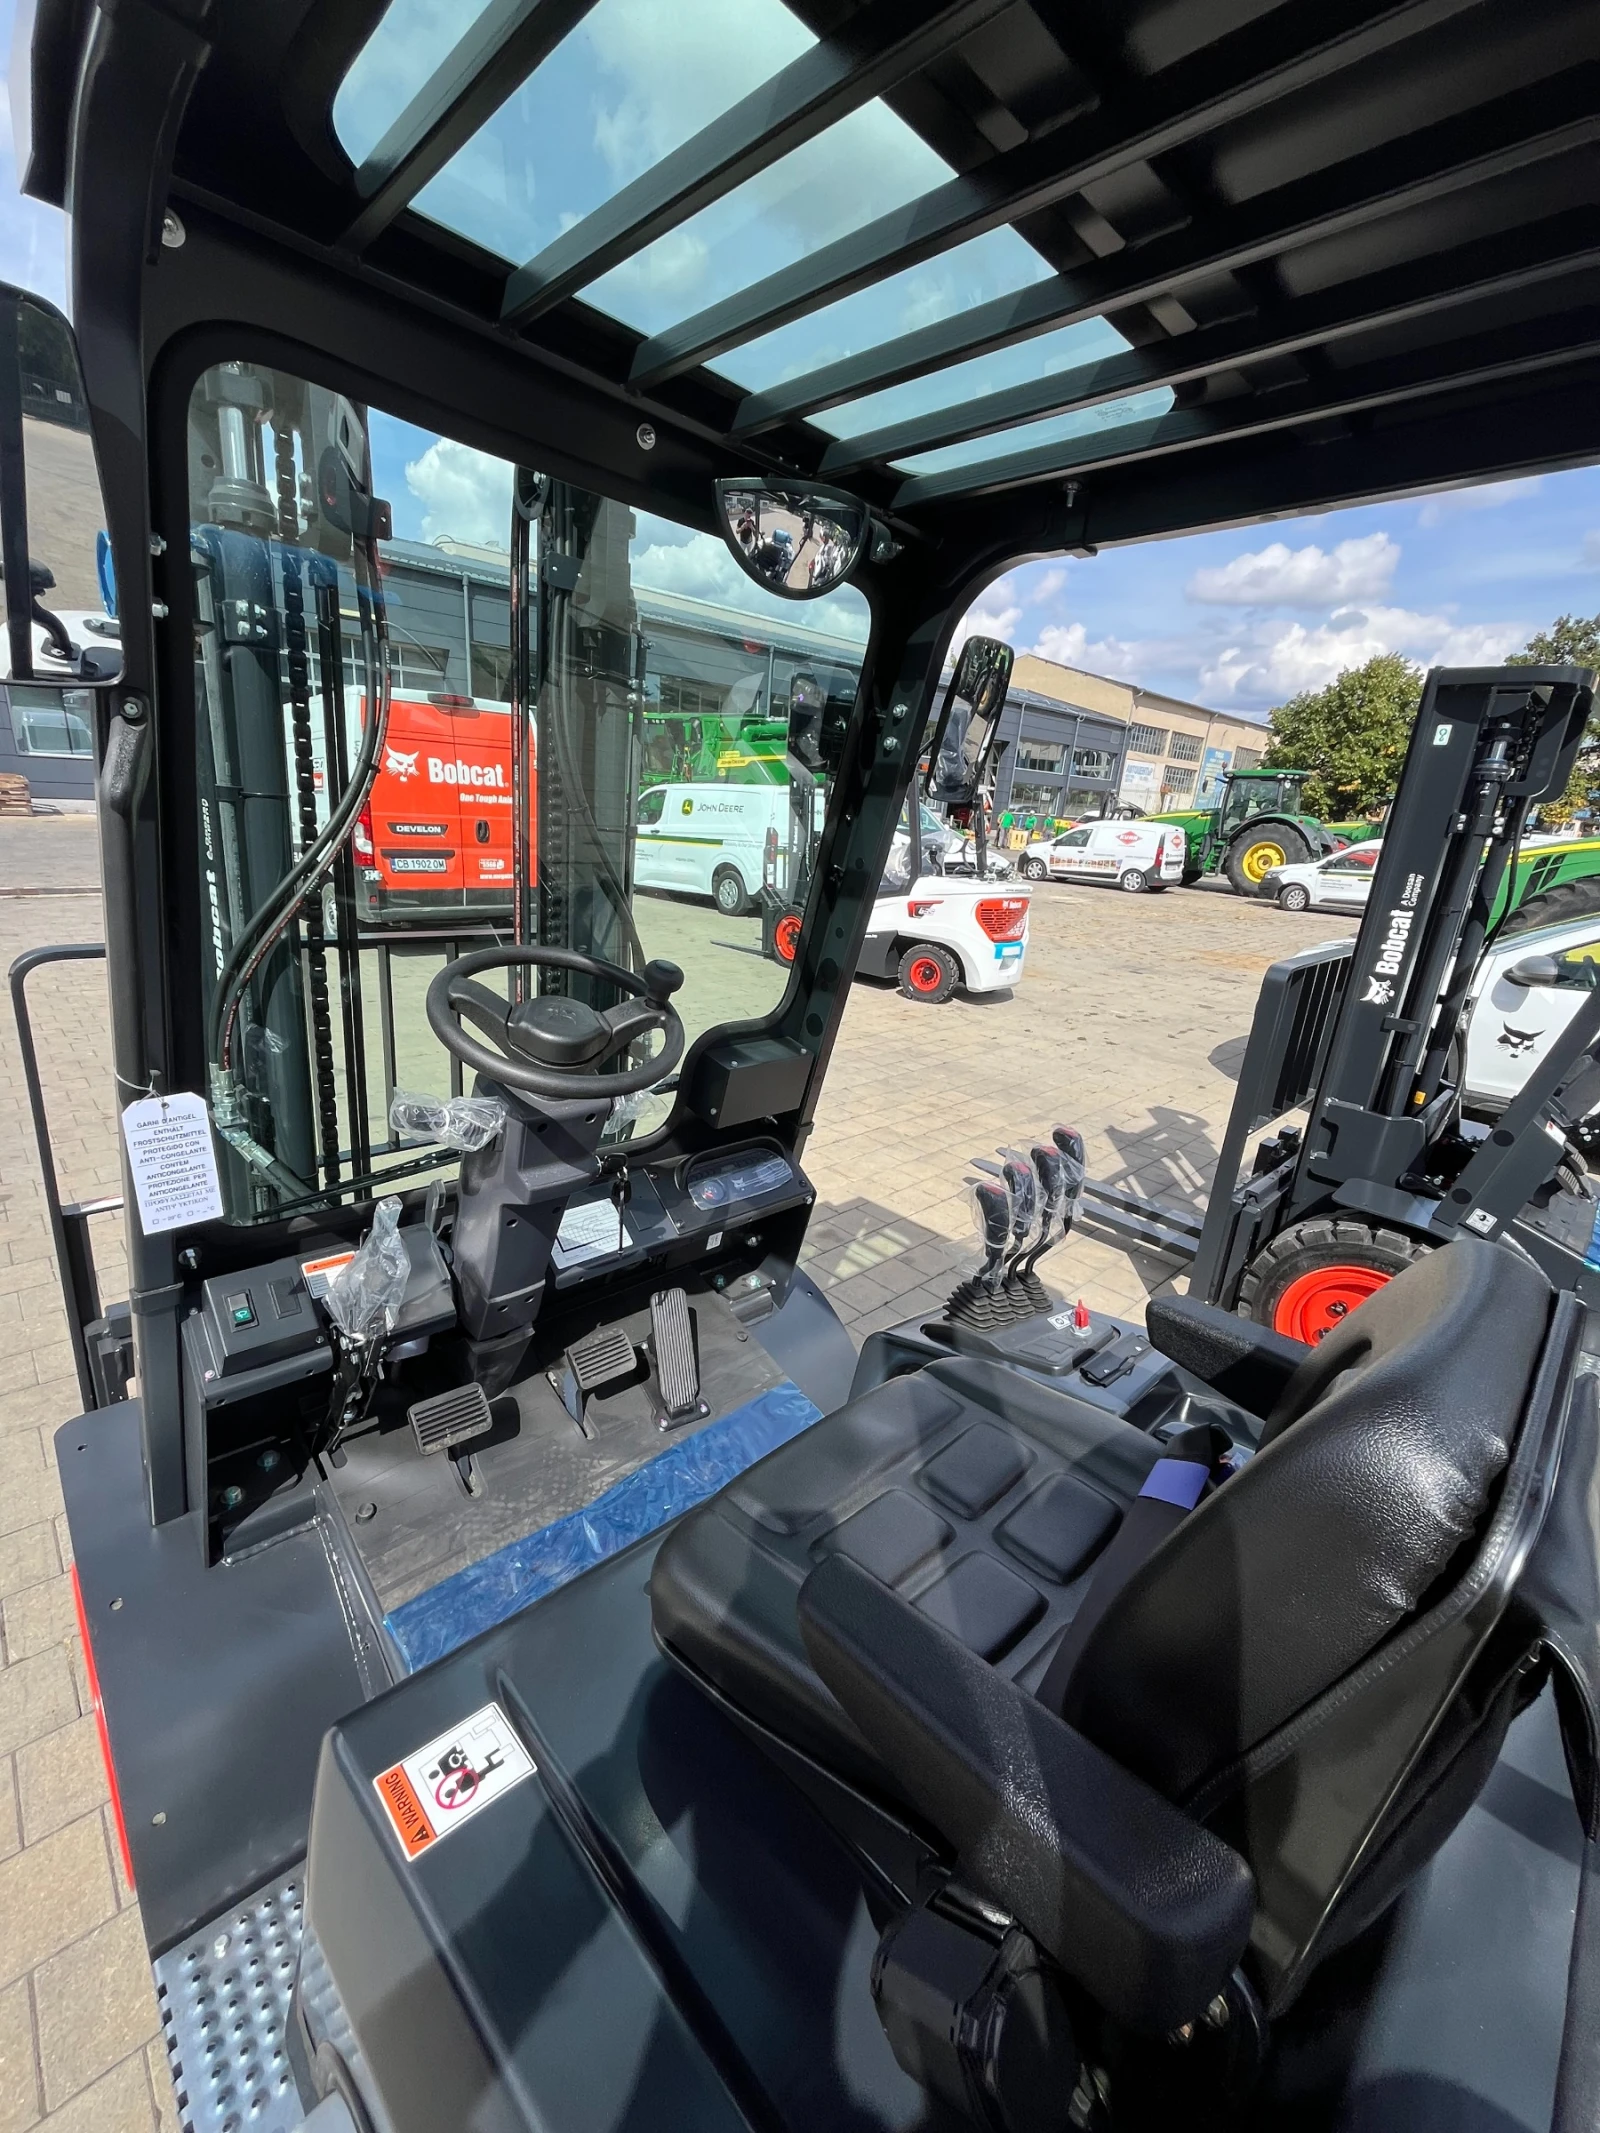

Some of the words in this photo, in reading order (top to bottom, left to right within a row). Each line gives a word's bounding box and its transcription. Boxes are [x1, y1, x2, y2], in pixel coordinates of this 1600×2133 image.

[427, 757, 505, 788] Bobcat
[460, 793, 474, 802] One
[475, 793, 497, 805] Tough
[697, 803, 718, 812] JOHN
[718, 803, 744, 813] DEERE
[396, 825, 442, 833] DEVELON
[396, 859, 409, 868] CB
[411, 859, 432, 869] 1902
[433, 860, 445, 869] OM
[1402, 873, 1416, 898] Doosan
[1408, 874, 1425, 907] Company
[1375, 909, 1414, 975] Bobcat
[136, 1120, 159, 1129] GARNI
[133, 1129, 206, 1147] FROSTSCHUTZMITTEL
[143, 1143, 184, 1155] PROTEGIDO
[185, 1140, 200, 1148] CON
[146, 1163, 206, 1180] ANTICONGELANTE
[147, 1176, 191, 1190] PROTEZIONE
[193, 1172, 207, 1180] PER
[148, 1180, 208, 1197] ANTICONGELANTE
[385, 1773, 420, 1829] WARNING
